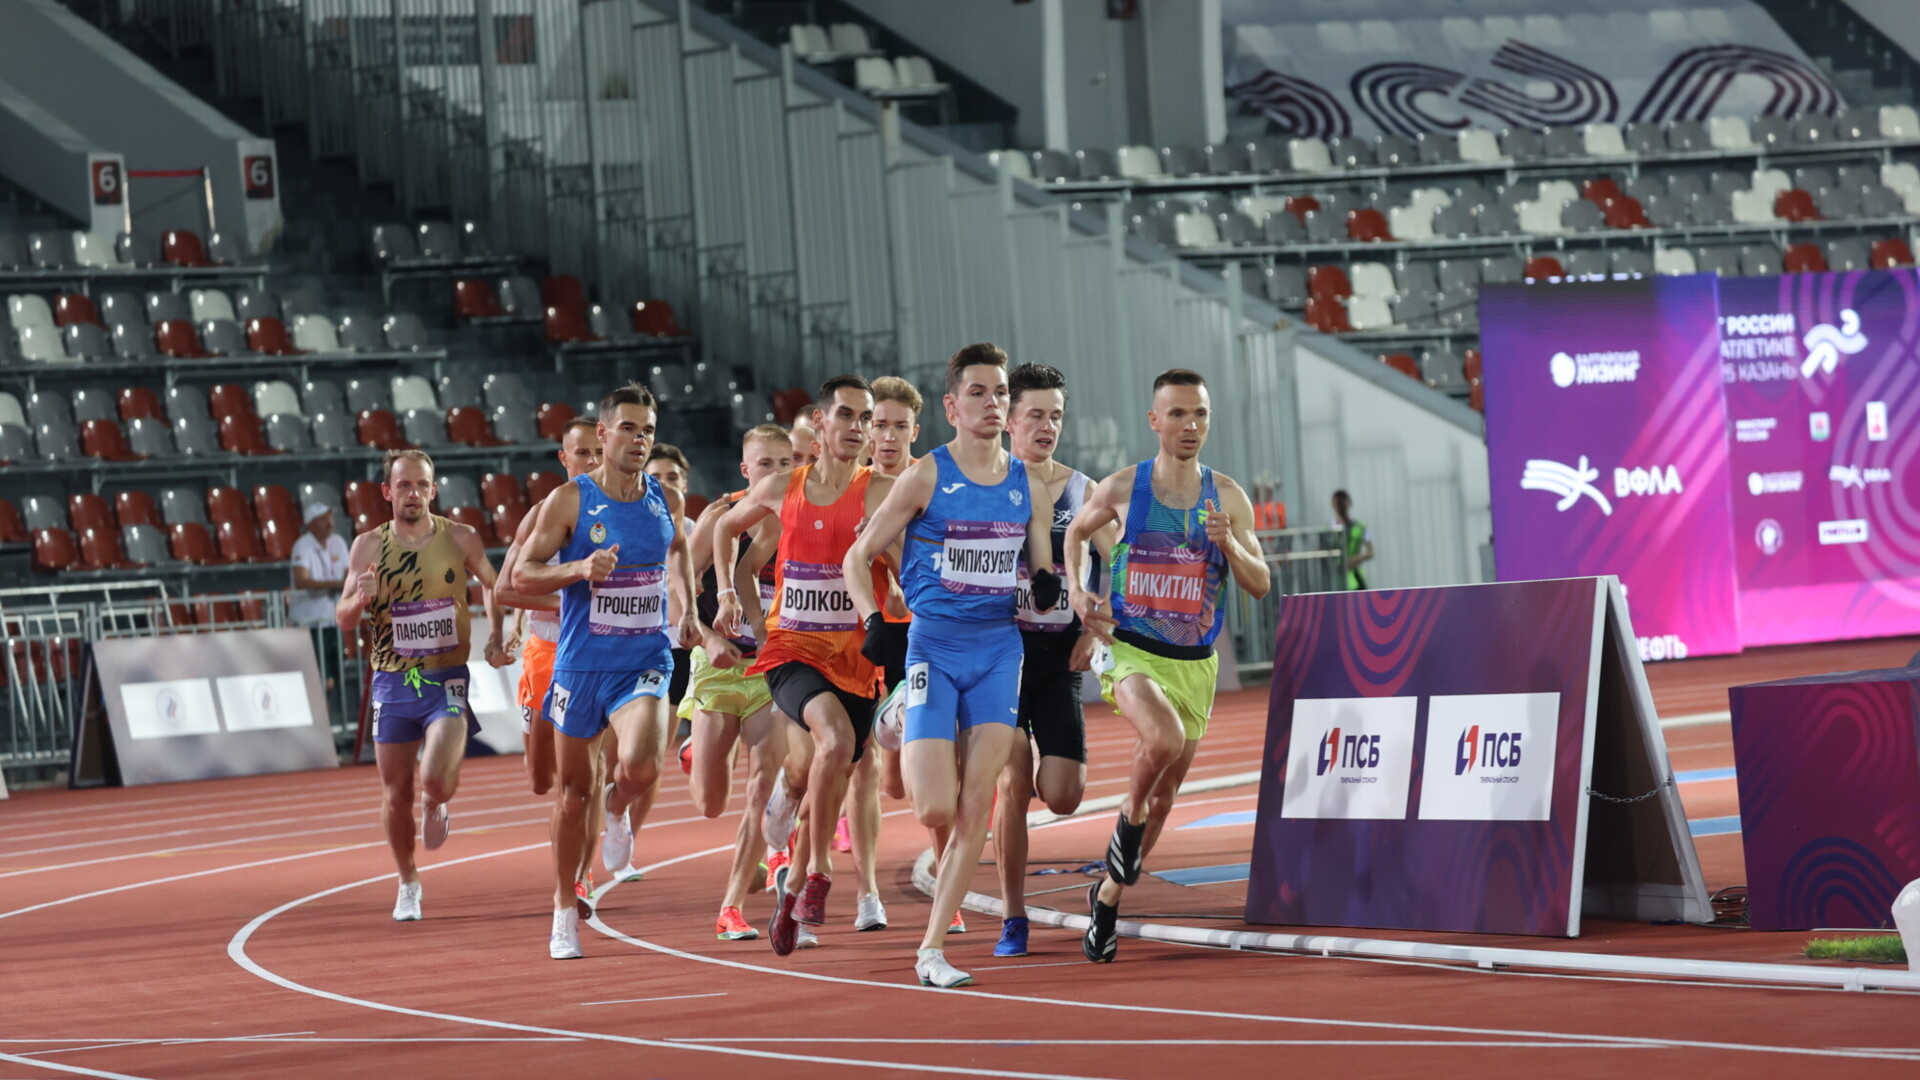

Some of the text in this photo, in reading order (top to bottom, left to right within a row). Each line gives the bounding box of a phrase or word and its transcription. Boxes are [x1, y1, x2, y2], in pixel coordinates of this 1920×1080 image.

[98, 165, 116, 193] 6
[251, 160, 269, 187] 6
[1726, 313, 1796, 335] РОССИИ
[1721, 336, 1797, 359] АТЛЕТИКЕ
[1576, 361, 1642, 385] ЛИЗИНГ
[1738, 361, 1798, 382] КАЗАНЬ
[1613, 464, 1684, 498] ВФЛА
[948, 547, 1016, 574] ЧИПИЗУБОВ
[1129, 571, 1204, 601] НИКИТИН
[596, 594, 660, 617] ТРОЦЕНКО
[785, 586, 854, 612] ВОЛКОВ
[396, 618, 453, 641] ПАНФЕРОВ
[641, 672, 661, 686] 14
[910, 671, 927, 690] 16
[447, 685, 464, 698] 13
[553, 692, 566, 713] 14
[1342, 734, 1381, 769] ПСБ
[1481, 732, 1522, 768] ПСБ
